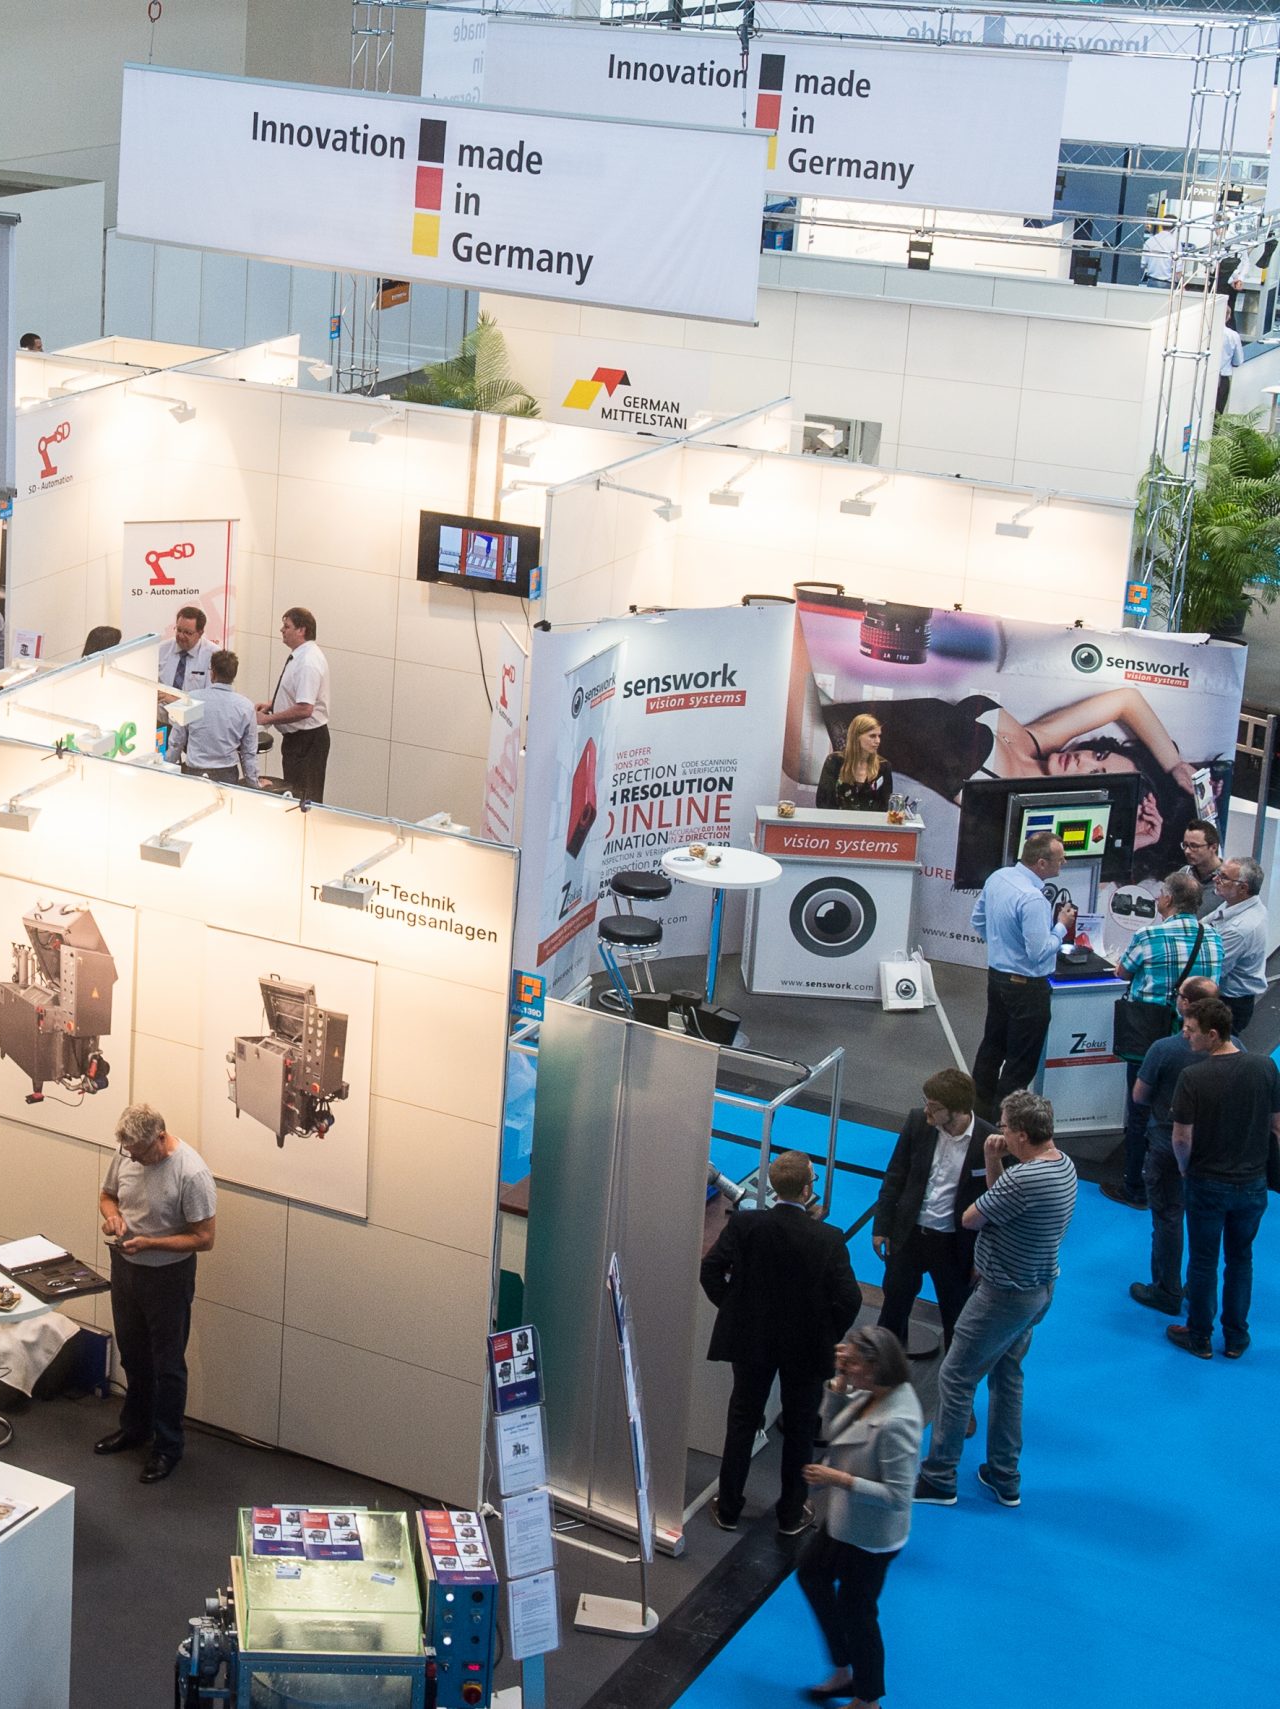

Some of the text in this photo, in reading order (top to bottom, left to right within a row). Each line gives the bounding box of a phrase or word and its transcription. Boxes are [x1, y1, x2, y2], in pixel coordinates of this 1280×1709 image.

[608, 53, 871, 99] Innovation made
[791, 107, 814, 134] in
[252, 111, 542, 175] Innovation made
[788, 147, 914, 190] Germany
[455, 183, 480, 216] in
[452, 232, 593, 286] Germany
[623, 395, 680, 414] GERMAN
[41, 474, 73, 490] Automation
[131, 588, 142, 596] SD
[150, 587, 199, 596] Automation
[1106, 657, 1189, 677] senswork
[585, 672, 616, 703] senswork
[623, 663, 738, 698] senswork
[1127, 672, 1187, 687] vision systems
[649, 692, 741, 710] vision systems
[629, 747, 652, 759] OFFER
[681, 759, 738, 768] CODE SCANNING
[688, 767, 737, 775] VERIFICATION
[620, 777, 734, 804] RESOLUTION
[622, 794, 732, 834] INLINE
[686, 832, 730, 842] DIRECTION
[784, 834, 898, 853] vision systems
[780, 979, 874, 991] www.senswork.com
[1070, 1033, 1107, 1054] Z Fokus
